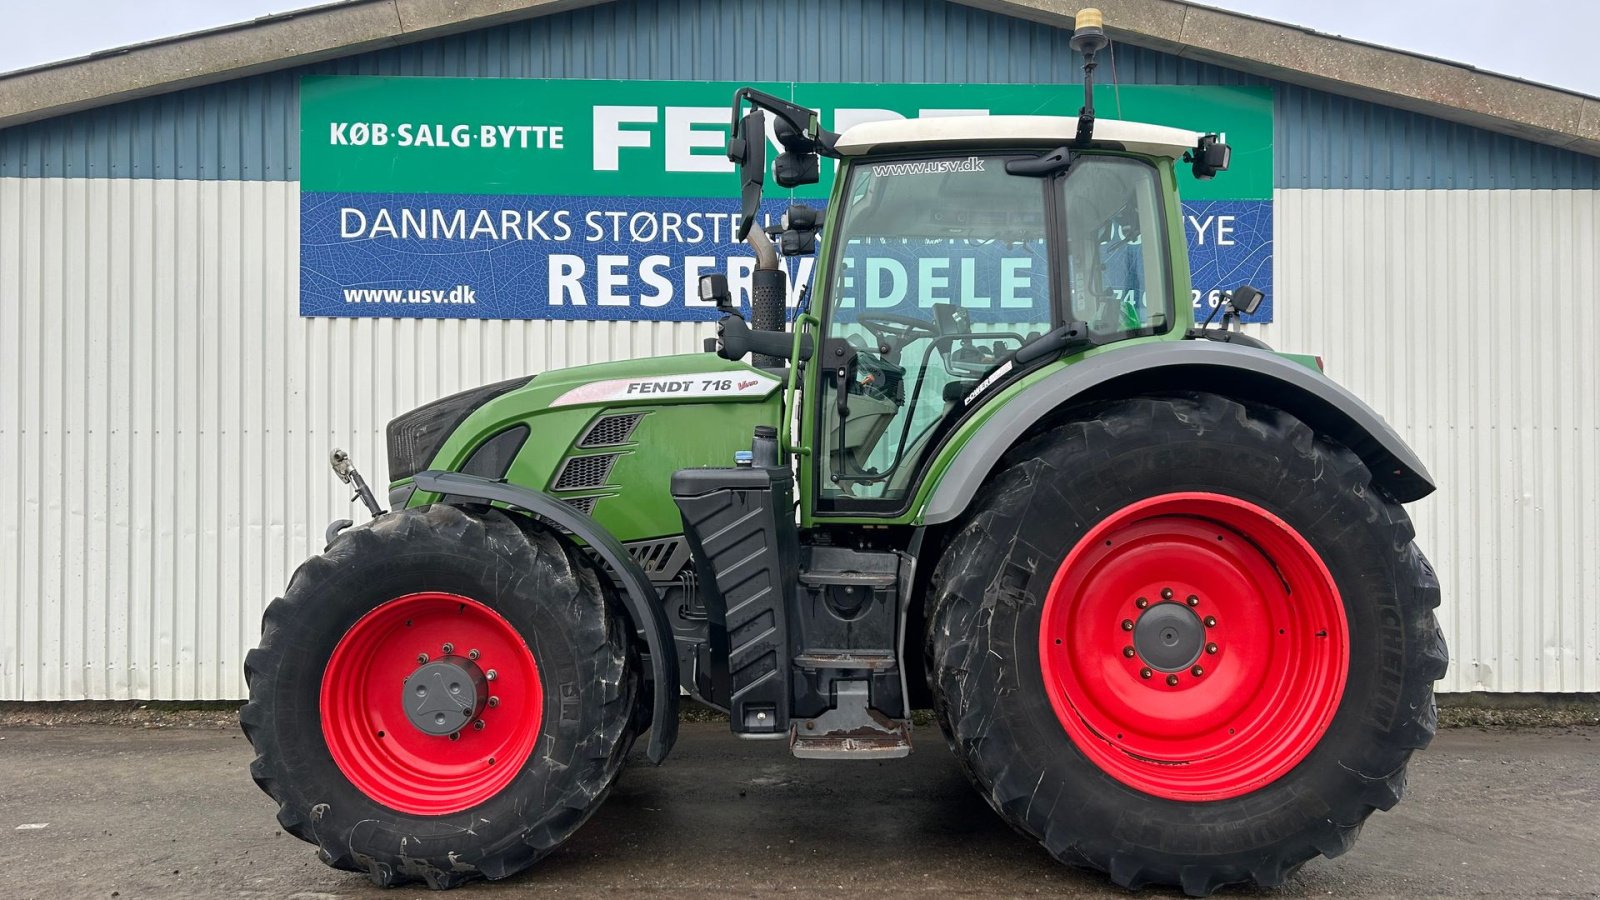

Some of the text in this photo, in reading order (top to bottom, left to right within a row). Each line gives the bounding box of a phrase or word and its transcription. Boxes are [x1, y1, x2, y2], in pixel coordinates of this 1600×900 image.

[872, 156, 985, 177] www.usv.dk
[340, 207, 572, 241] DANMARKS
[585, 210, 748, 244] STØRSTE
[1181, 215, 1236, 246] YE
[547, 253, 1033, 309] RESERVEDELE
[343, 285, 477, 306] www.usv.dk
[626, 380, 693, 395] FENDT
[701, 379, 732, 392] 718
